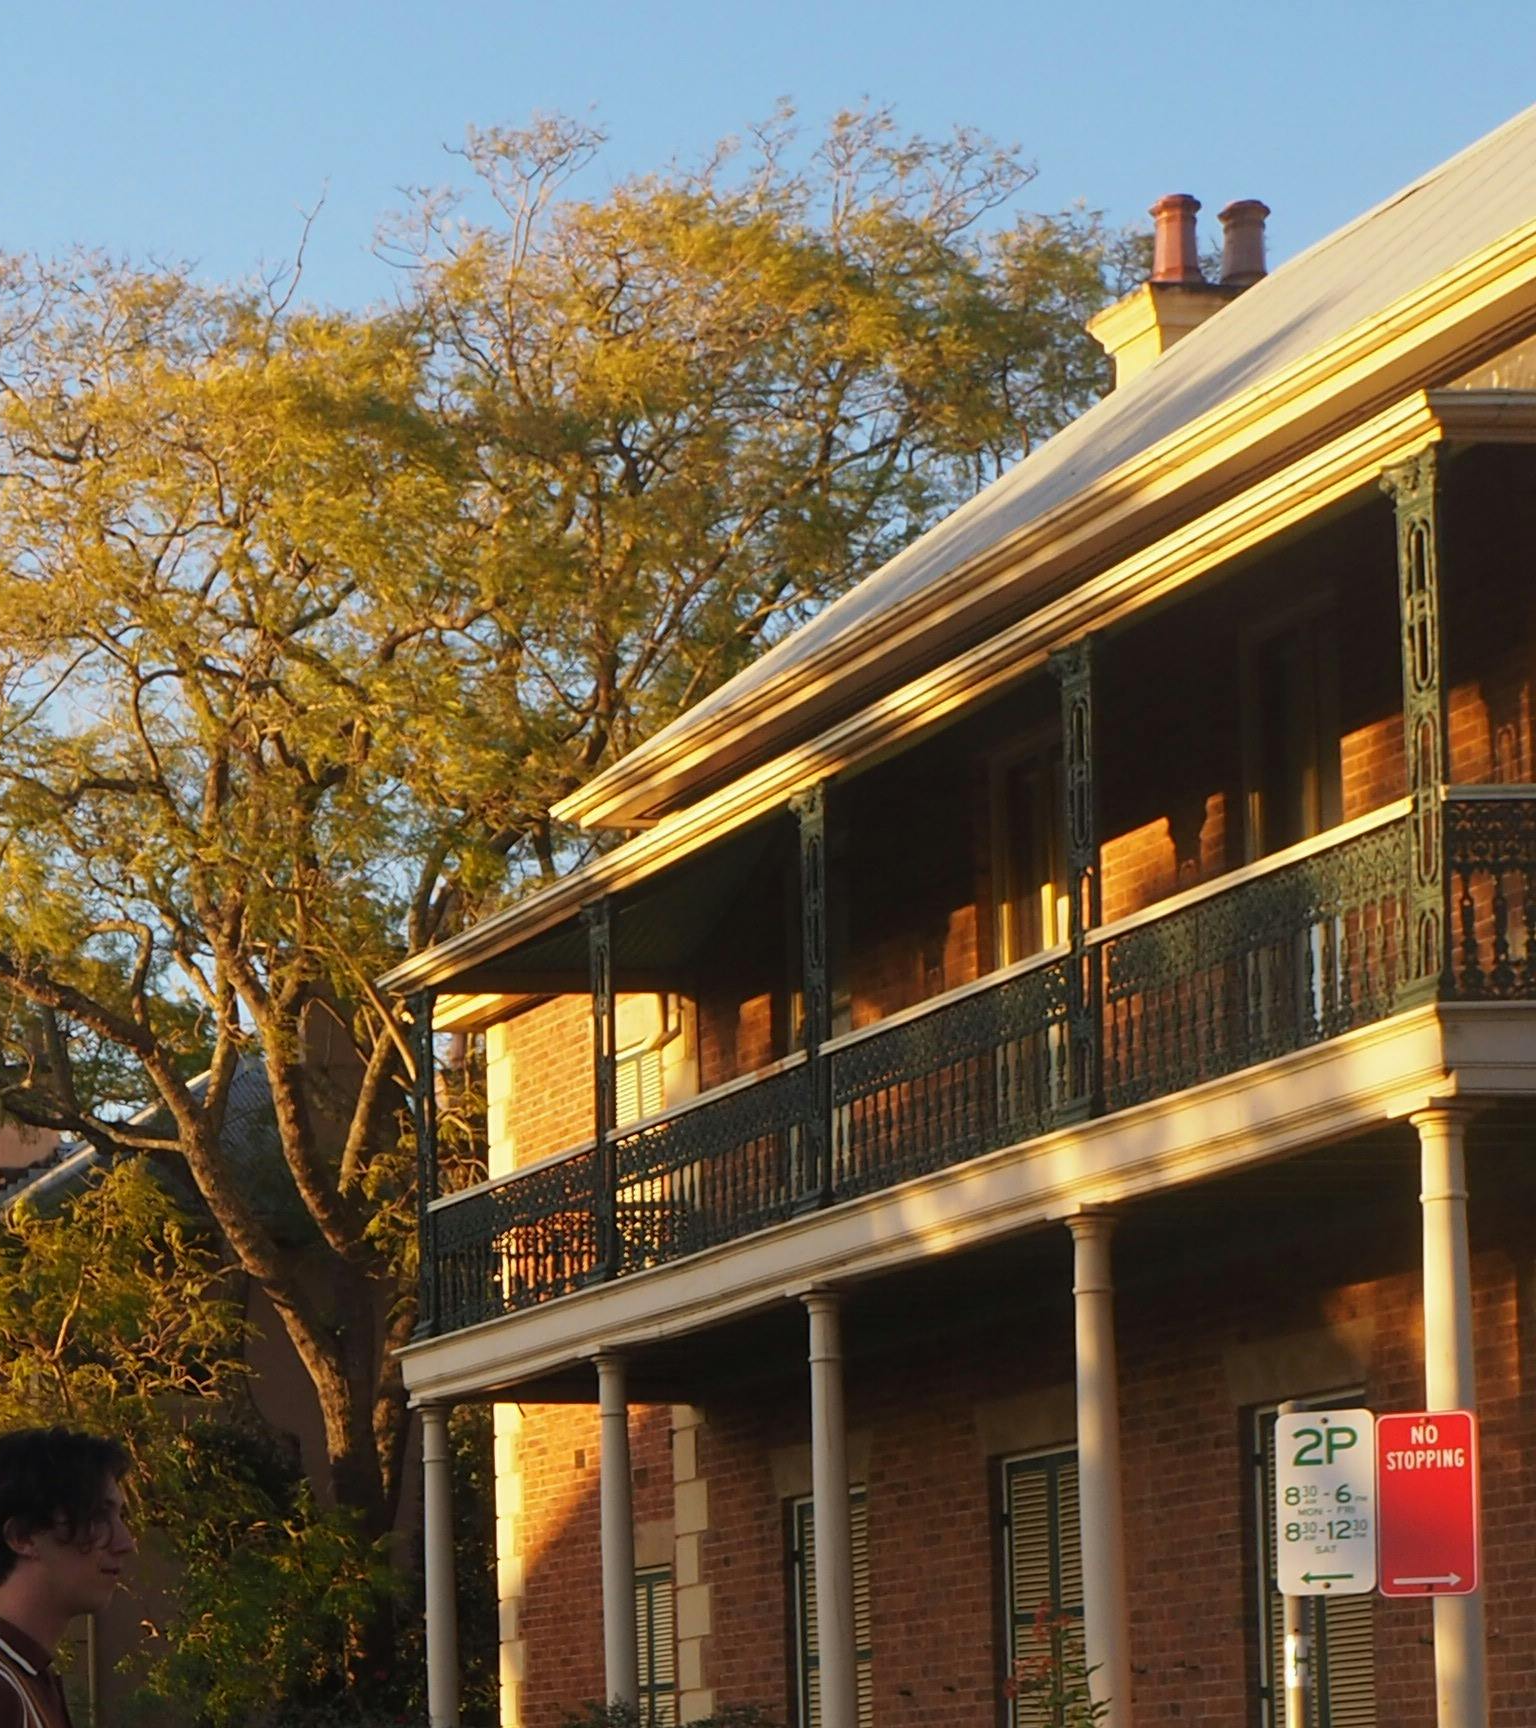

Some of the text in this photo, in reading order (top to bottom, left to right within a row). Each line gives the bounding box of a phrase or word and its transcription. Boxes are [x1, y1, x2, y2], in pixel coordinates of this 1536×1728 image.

[1410, 1424, 1439, 1445] NO
[1292, 1426, 1358, 1467] 2P
[1386, 1448, 1465, 1472] STOPPING
[1297, 1507, 1323, 1516] MON
[1337, 1505, 1356, 1514] FRI
[1315, 1544, 1337, 1555] SAT
